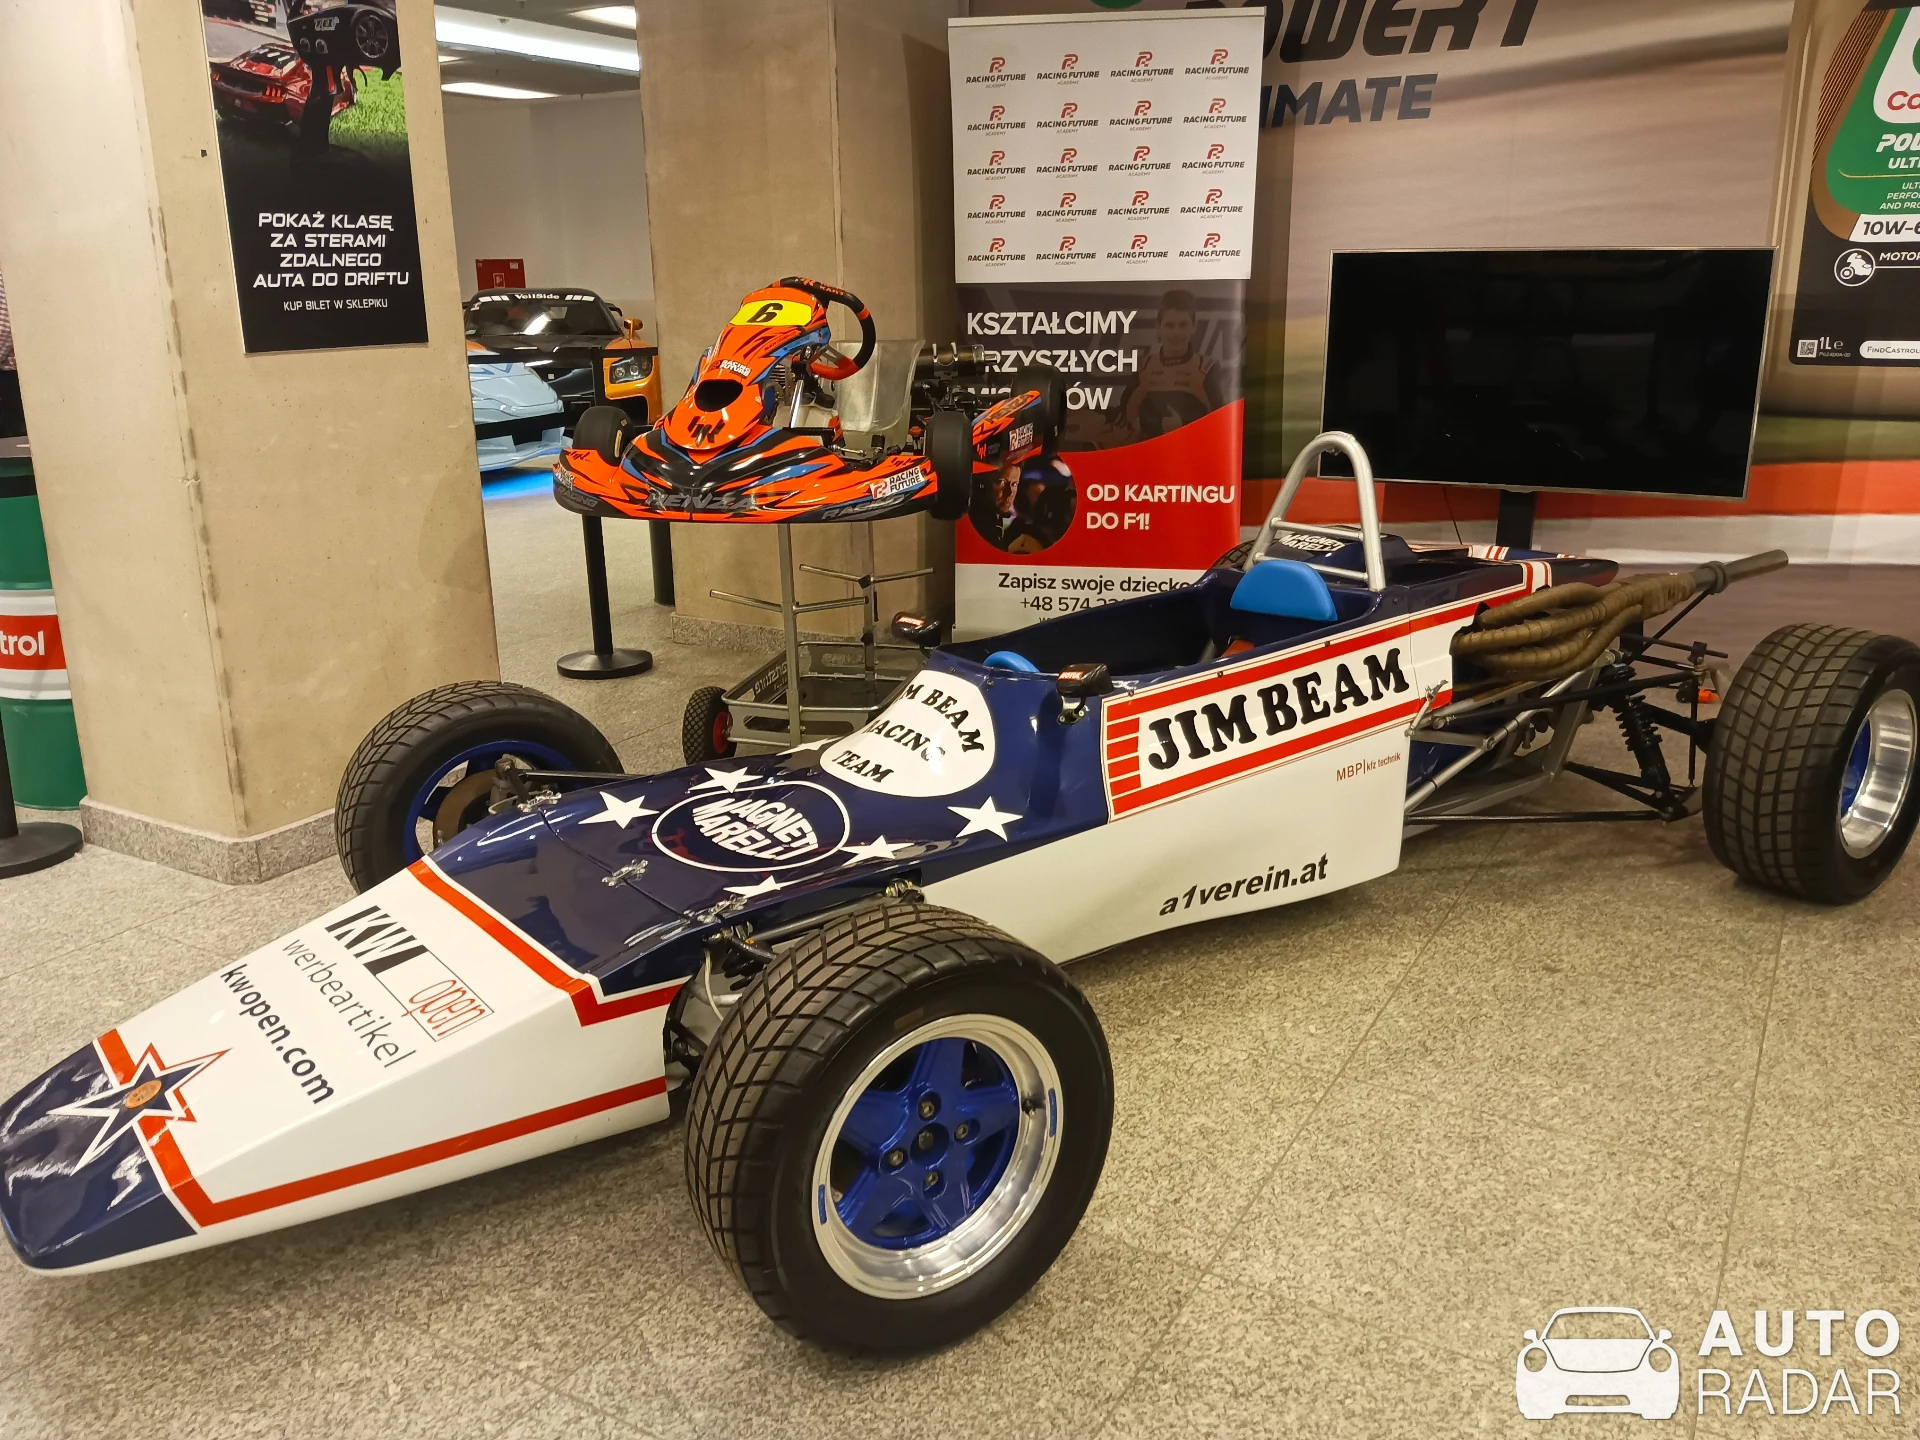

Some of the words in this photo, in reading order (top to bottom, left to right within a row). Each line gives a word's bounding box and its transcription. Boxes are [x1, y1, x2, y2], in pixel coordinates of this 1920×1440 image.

[1037, 72, 1067, 81] RACING
[1067, 70, 1099, 79] FUTURE
[1110, 69, 1141, 79] RACING
[1140, 68, 1174, 77] FUTURE
[1185, 68, 1216, 77] RACING
[1216, 66, 1249, 74] FUTURE
[966, 75, 995, 85] RACING
[995, 73, 1026, 82] FUTURE
[1259, 73, 1438, 128] IMATE
[1037, 121, 1067, 130] RACING
[1066, 120, 1099, 128] FUTURE
[1109, 118, 1140, 127] RACING
[1139, 117, 1172, 125] FUTURE
[1183, 117, 1214, 125] RACING
[1214, 115, 1247, 123] FUTURE
[967, 123, 995, 132] RACING
[995, 121, 1026, 130] FUTURE
[967, 168, 995, 177] RACING
[1036, 166, 1066, 175] RACING
[1108, 164, 1139, 172] RACING
[1139, 162, 1171, 170] FUTURE
[1182, 162, 1213, 171] RACING
[1180, 207, 1211, 215] RACING
[1880, 202, 1901, 210] AND
[967, 212, 995, 220] RACING
[995, 210, 1026, 218] FUTURE
[1036, 210, 1066, 219] RACING
[1067, 208, 1097, 216] FUTURE
[1107, 208, 1138, 217] RACING
[258, 211, 325, 228] POKAŻ
[331, 214, 395, 231] KLASĘ
[270, 233, 298, 248] ZA
[304, 234, 386, 248] STERAMI
[279, 253, 382, 268] ZDALNEGO
[968, 255, 995, 263] RACING
[1036, 254, 1065, 262] RACING
[1107, 252, 1137, 260] RACING
[1179, 251, 1209, 259] RACING
[253, 273, 305, 288] AUTA
[312, 273, 338, 287] DO
[344, 272, 409, 287] DRIFTU
[283, 301, 303, 311] KUP
[305, 300, 331, 310] BILET
[333, 300, 344, 309] W
[346, 299, 388, 309] SKLEPIKU
[747, 303, 783, 323] 6
[967, 310, 1138, 335] KSZTAŁCIMY
[985, 350, 1138, 373] RZYSZŁYCH
[889, 467, 920, 485] RACING
[890, 475, 921, 492] FUTURE
[1086, 484, 1119, 502] OD
[1124, 485, 1235, 504] KARTINGU
[1086, 512, 1119, 530] DO
[1124, 513, 1150, 530] F1!
[998, 572, 1047, 592] Zapisz
[1061, 575, 1115, 595] swoje
[1020, 596, 1053, 611] +48
[1058, 597, 1091, 612] 574
[1148, 693, 1257, 770] JIM
[1257, 648, 1410, 737] BEAM
[921, 689, 985, 752] BEAM
[831, 750, 894, 783] TEAM
[1159, 852, 1328, 916] a1verein.at
[282, 939, 417, 1069] werbeartikel
[401, 979, 486, 1037] open
[220, 963, 335, 1105] kwopen.com
